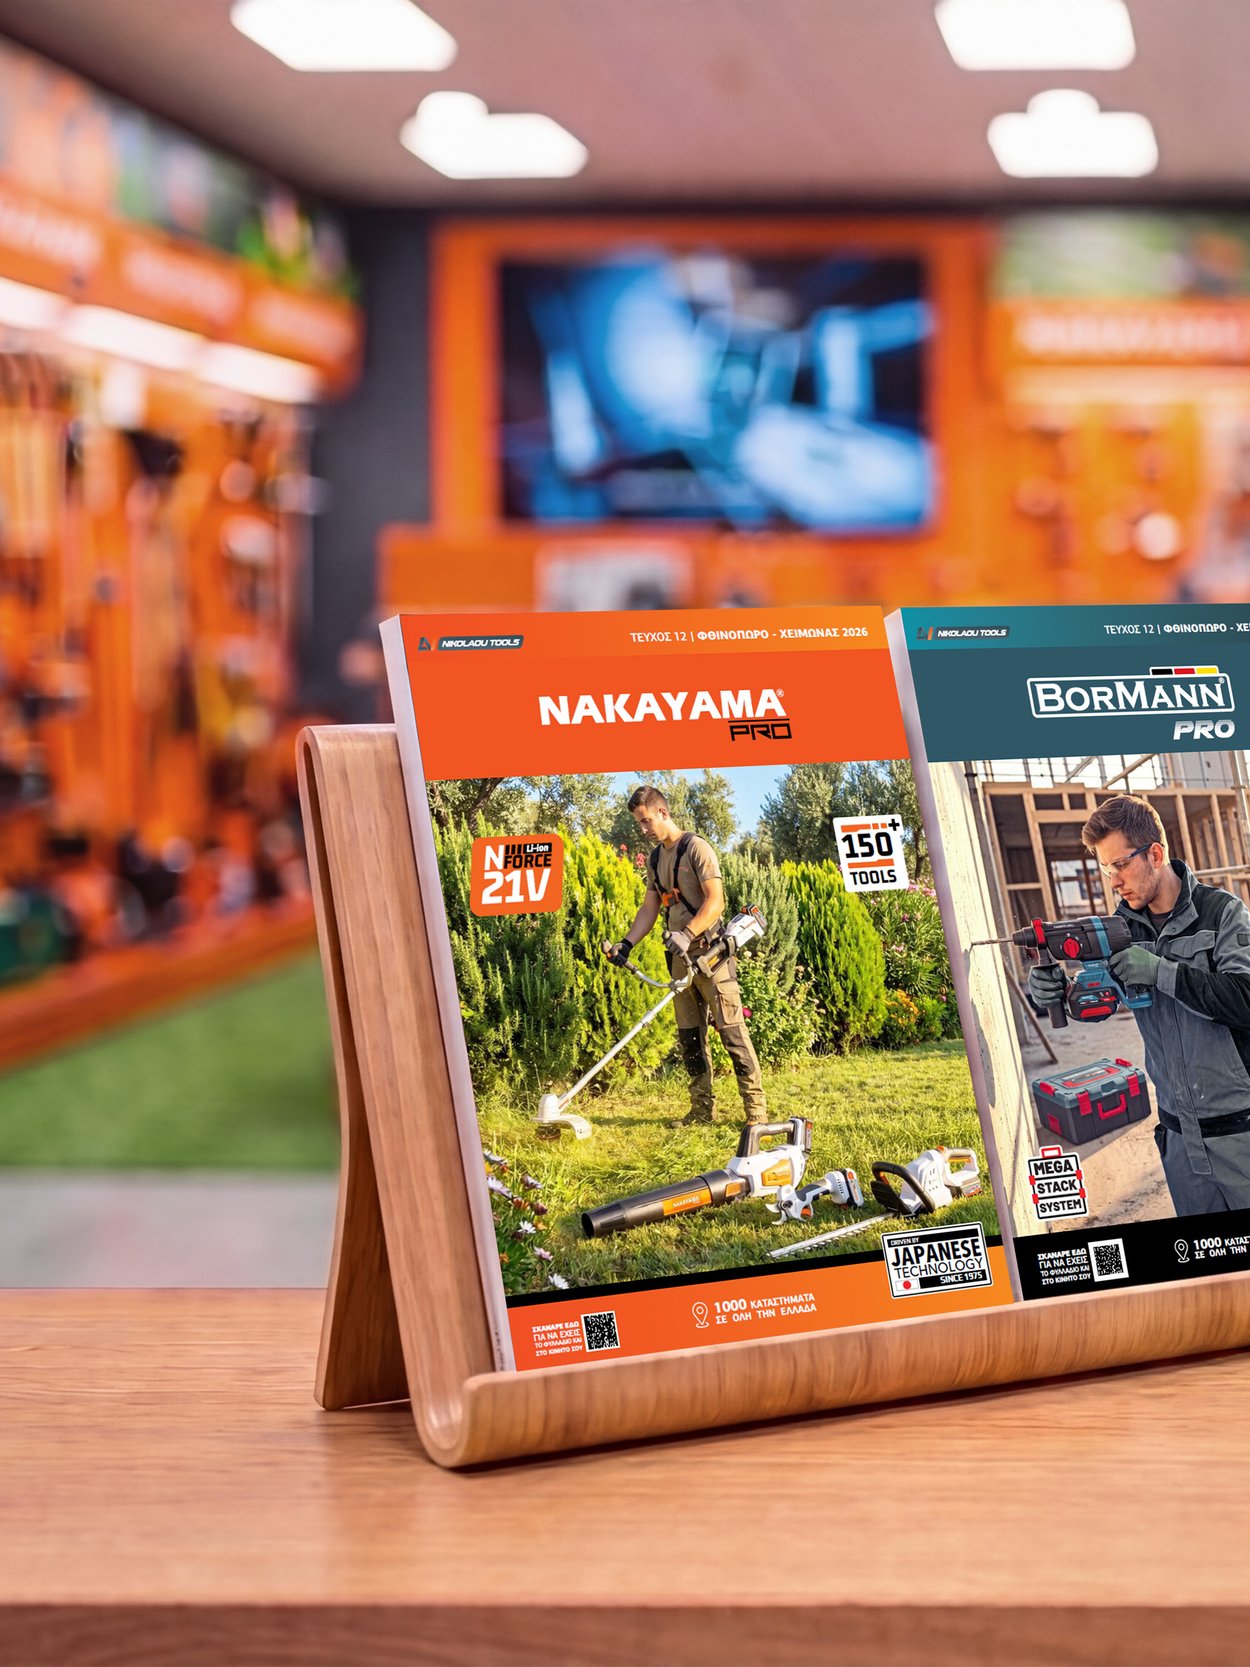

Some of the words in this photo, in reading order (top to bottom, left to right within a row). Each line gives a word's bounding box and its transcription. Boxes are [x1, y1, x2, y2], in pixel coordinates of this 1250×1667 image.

[630, 632, 672, 642] ΤΕΥΧΟΣ
[674, 632, 687, 641] 12
[697, 630, 769, 641] ΦΘΙΝΟΠΩΡΟ
[779, 628, 840, 639] ΧΕΙΜΩΝΑΣ
[842, 627, 868, 637] 2026
[1104, 625, 1141, 635] ΤΕΥΧΟΣ
[1143, 625, 1154, 634] 12
[1163, 623, 1227, 633] ΦΘΙΝΟΠΩΡΟ
[442, 640, 488, 648] NIKOLAOU
[729, 723, 792, 741] PRO
[1173, 719, 1235, 740] PRO
[850, 869, 897, 885] TOOLS
[482, 868, 551, 904] 21V
[1033, 1159, 1074, 1176] MEGA
[1037, 1179, 1078, 1194] STACK
[1040, 1199, 1082, 1213] SYSTEM
[890, 1238, 911, 1246] DRIVEN
[1193, 1237, 1222, 1250] 1000
[891, 1238, 982, 1267] JAPANESE
[1194, 1250, 1205, 1259] ΣΕ
[1209, 1248, 1227, 1257] ΟΛΗ
[1230, 1245, 1247, 1254] ΤΗΝ
[894, 1257, 983, 1279] TECHNOLOGY
[1053, 1258, 1065, 1267] ΝΑ
[1066, 1255, 1088, 1266] ΕΧΕΙΣ
[940, 1274, 964, 1284] SINCE
[964, 1271, 983, 1280] 1975
[714, 1298, 746, 1313] 1000
[750, 1293, 815, 1309] ΚΑΤΑΣΤΗΜΑΤΑ
[715, 1315, 728, 1324] ΣΕ
[732, 1312, 752, 1322] ΟΛΗ
[756, 1309, 776, 1319] ΤΗΝ
[780, 1304, 816, 1316] ΕΛΛΑΔΑ
[547, 1332, 558, 1340] ΝΑ
